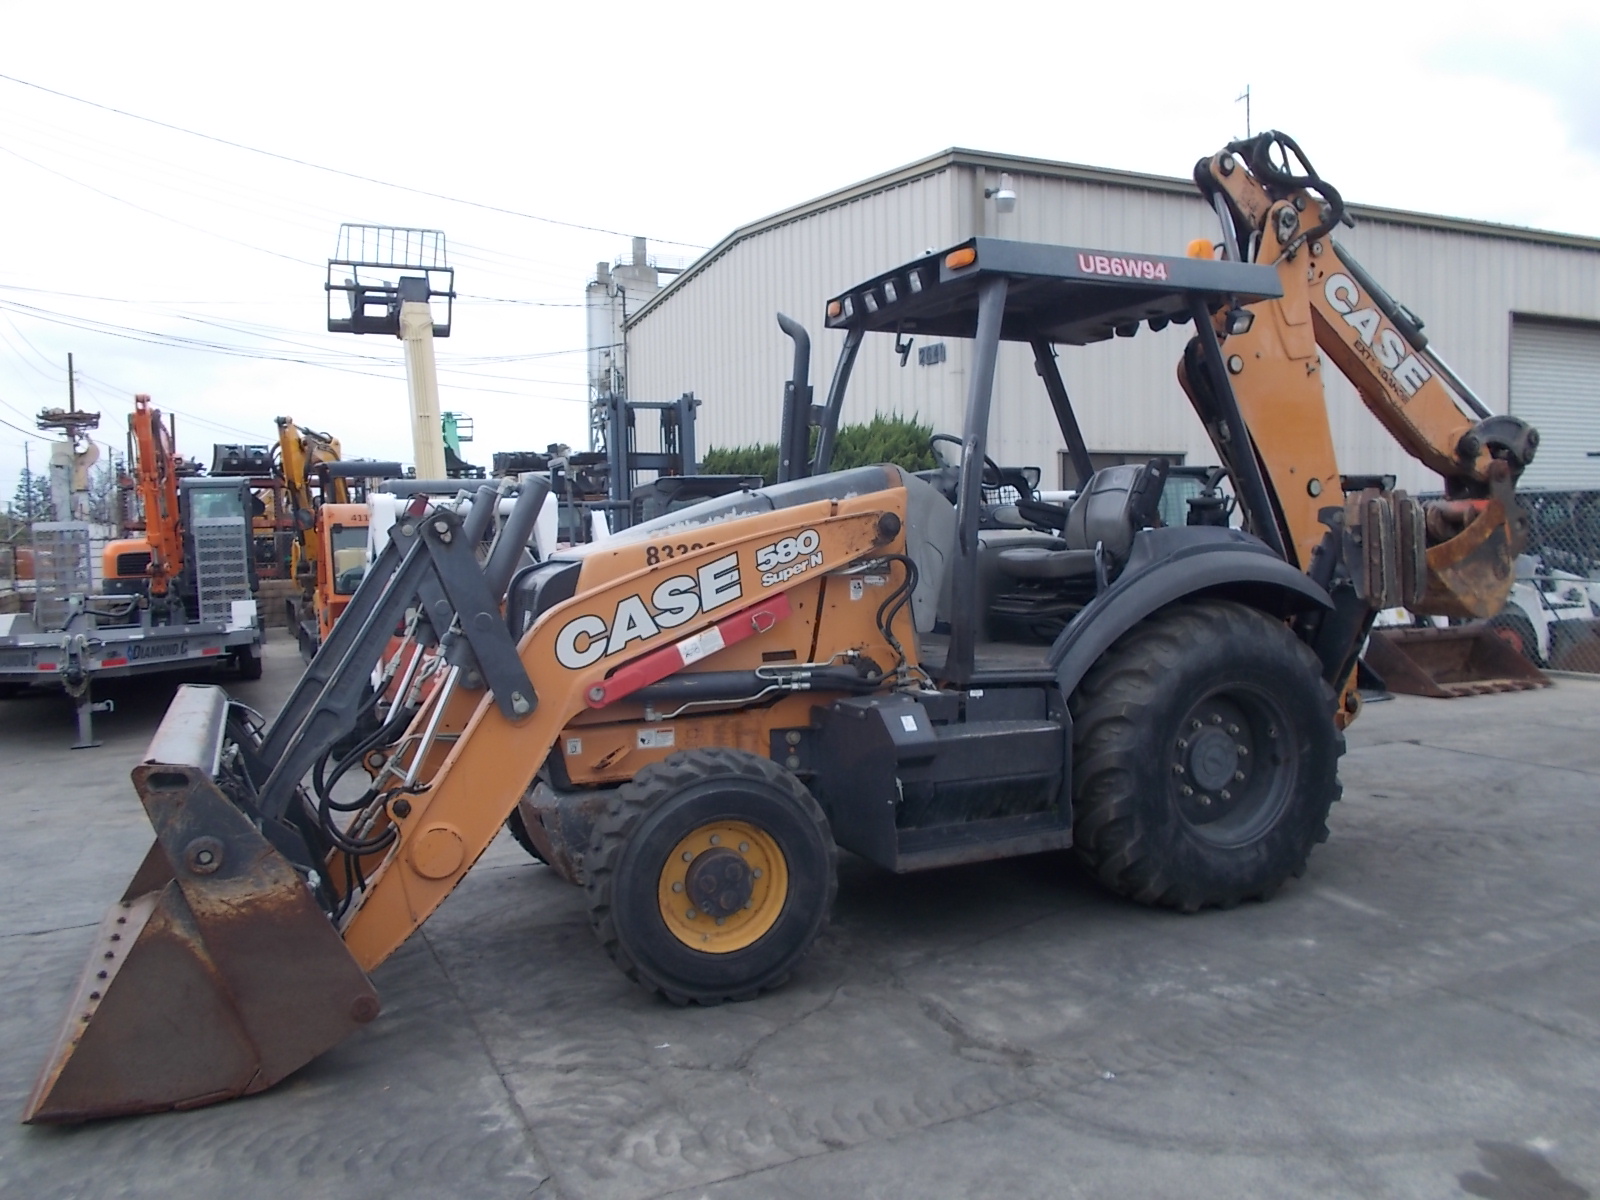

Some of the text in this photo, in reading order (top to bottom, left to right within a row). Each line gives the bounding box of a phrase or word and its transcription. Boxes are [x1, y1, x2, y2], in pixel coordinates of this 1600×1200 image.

[1078, 253, 1168, 281] UB6W94
[1324, 272, 1432, 398] CASE
[755, 528, 821, 573] 580
[761, 550, 824, 588] Super N
[555, 551, 743, 670] CASE
[181, 639, 189, 655] C
